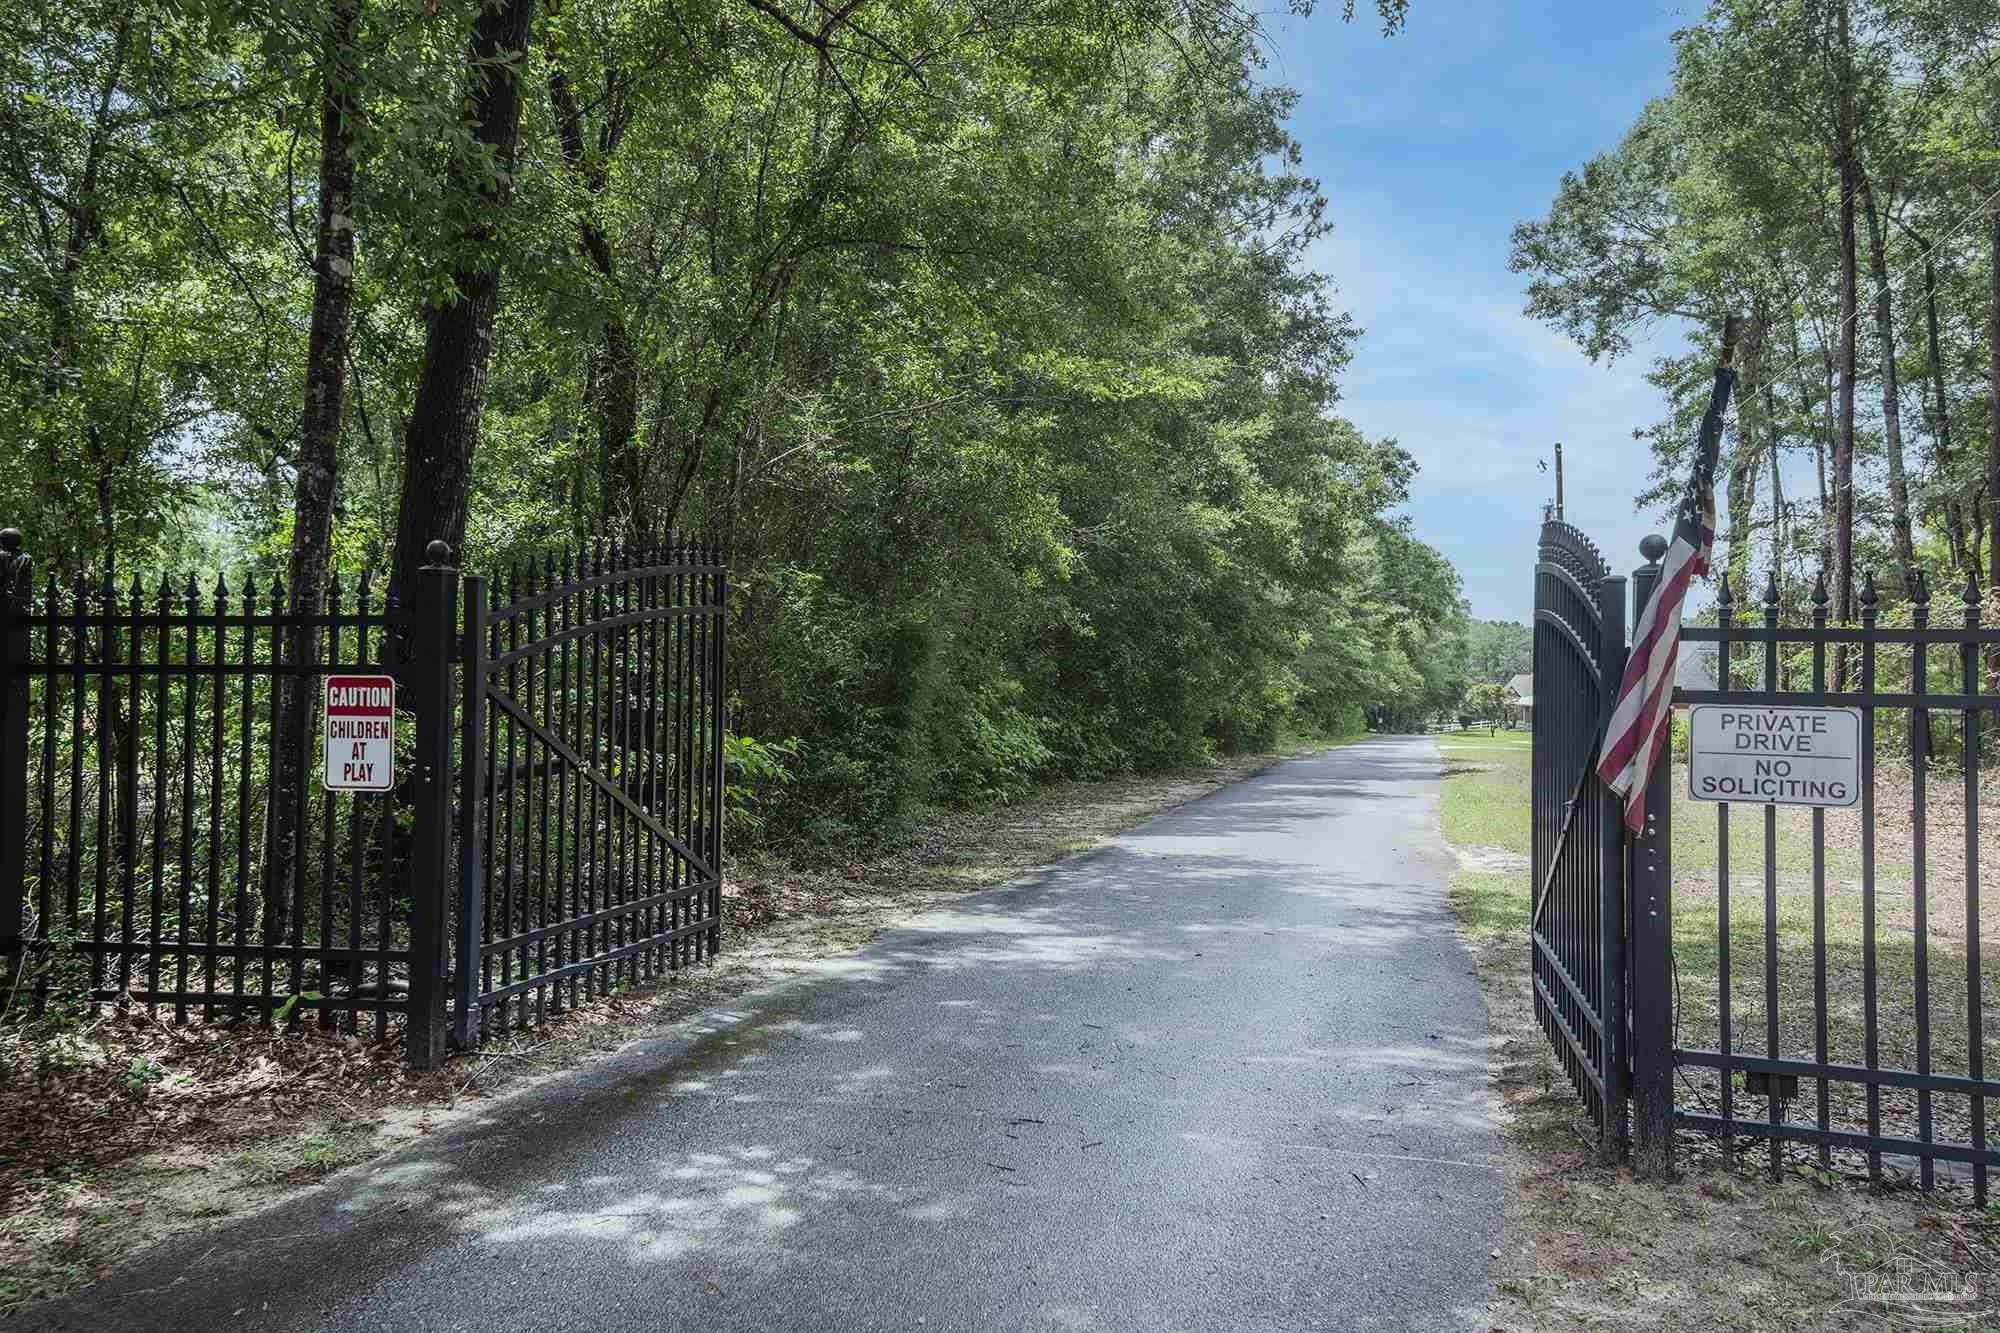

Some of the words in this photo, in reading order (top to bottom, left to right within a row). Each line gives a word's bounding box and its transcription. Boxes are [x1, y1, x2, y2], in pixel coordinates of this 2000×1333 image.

[330, 687, 390, 707] CAUTION
[330, 720, 389, 739] CHILDREN
[1720, 713, 1828, 733] PRIVATE
[351, 742, 368, 760] AT
[1735, 733, 1812, 752] DRIVE
[344, 763, 374, 782] PLAY
[1755, 759, 1792, 777] NO
[1702, 776, 1847, 799] SOLICITING
